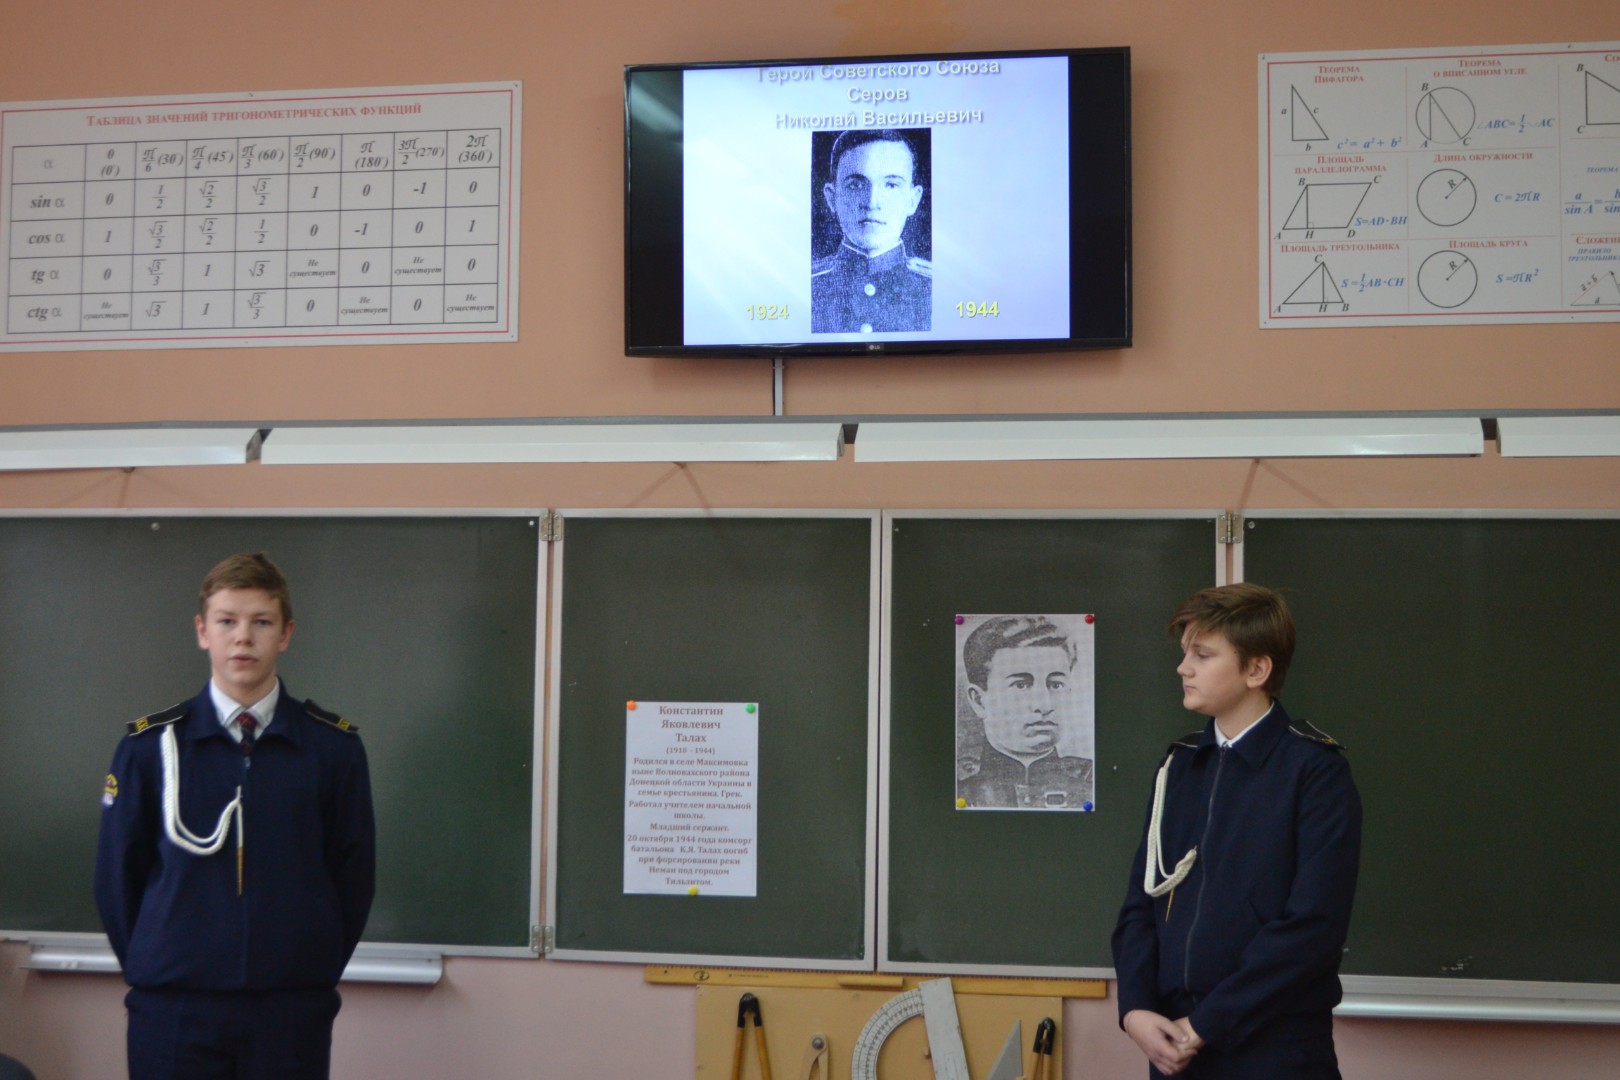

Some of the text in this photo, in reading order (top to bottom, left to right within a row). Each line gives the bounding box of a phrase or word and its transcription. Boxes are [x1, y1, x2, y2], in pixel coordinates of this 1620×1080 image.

[1459, 60, 1502, 68] ТЕОРЕМА
[757, 58, 1000, 84] Герой Советского Союза
[1318, 66, 1360, 74] ТЕОРЕМА
[847, 86, 908, 106] Серов
[86, 114, 142, 126] ТАБЛИЦА
[146, 112, 208, 124] ЗНАЧЕНИЙ
[360, 103, 422, 115] ФУНКЦИЙ
[774, 108, 983, 130] Николай Васильевич
[107, 150, 115, 160] 0
[746, 304, 789, 320] 1924
[956, 301, 1000, 318] 1944
[660, 705, 724, 716] Константин
[662, 719, 720, 729] Яковлевич
[676, 732, 706, 742] Талах
[634, 757, 668, 766] Родился
[720, 770, 750, 778] района
[672, 778, 706, 786] области
[695, 867, 729, 876] городом
